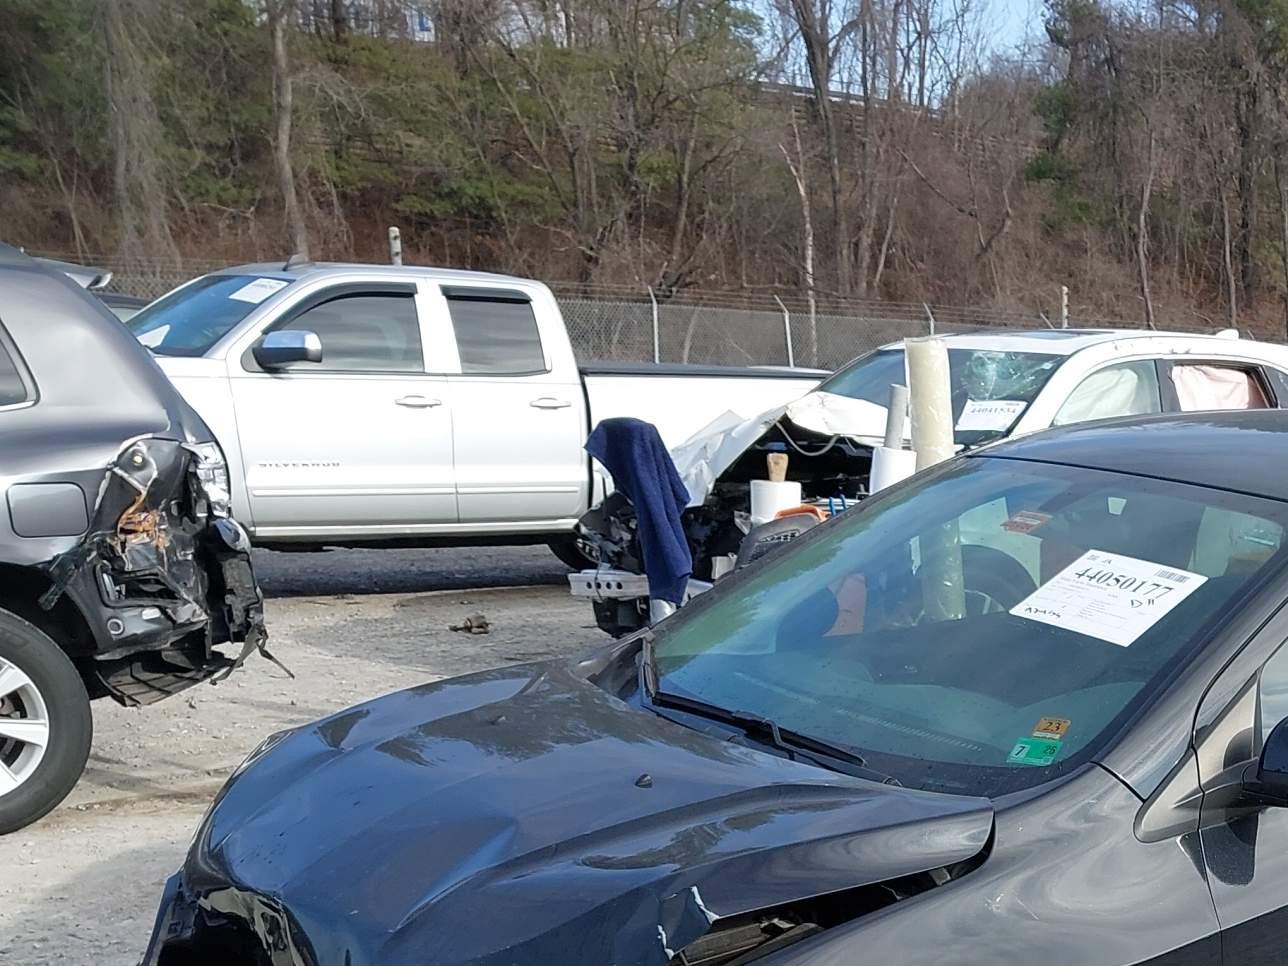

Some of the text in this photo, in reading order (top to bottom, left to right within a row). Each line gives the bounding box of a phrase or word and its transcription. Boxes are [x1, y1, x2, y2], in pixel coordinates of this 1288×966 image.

[1075, 567, 1174, 600] 44050177
[1043, 721, 1060, 731] 23
[1015, 745, 1026, 756] 7
